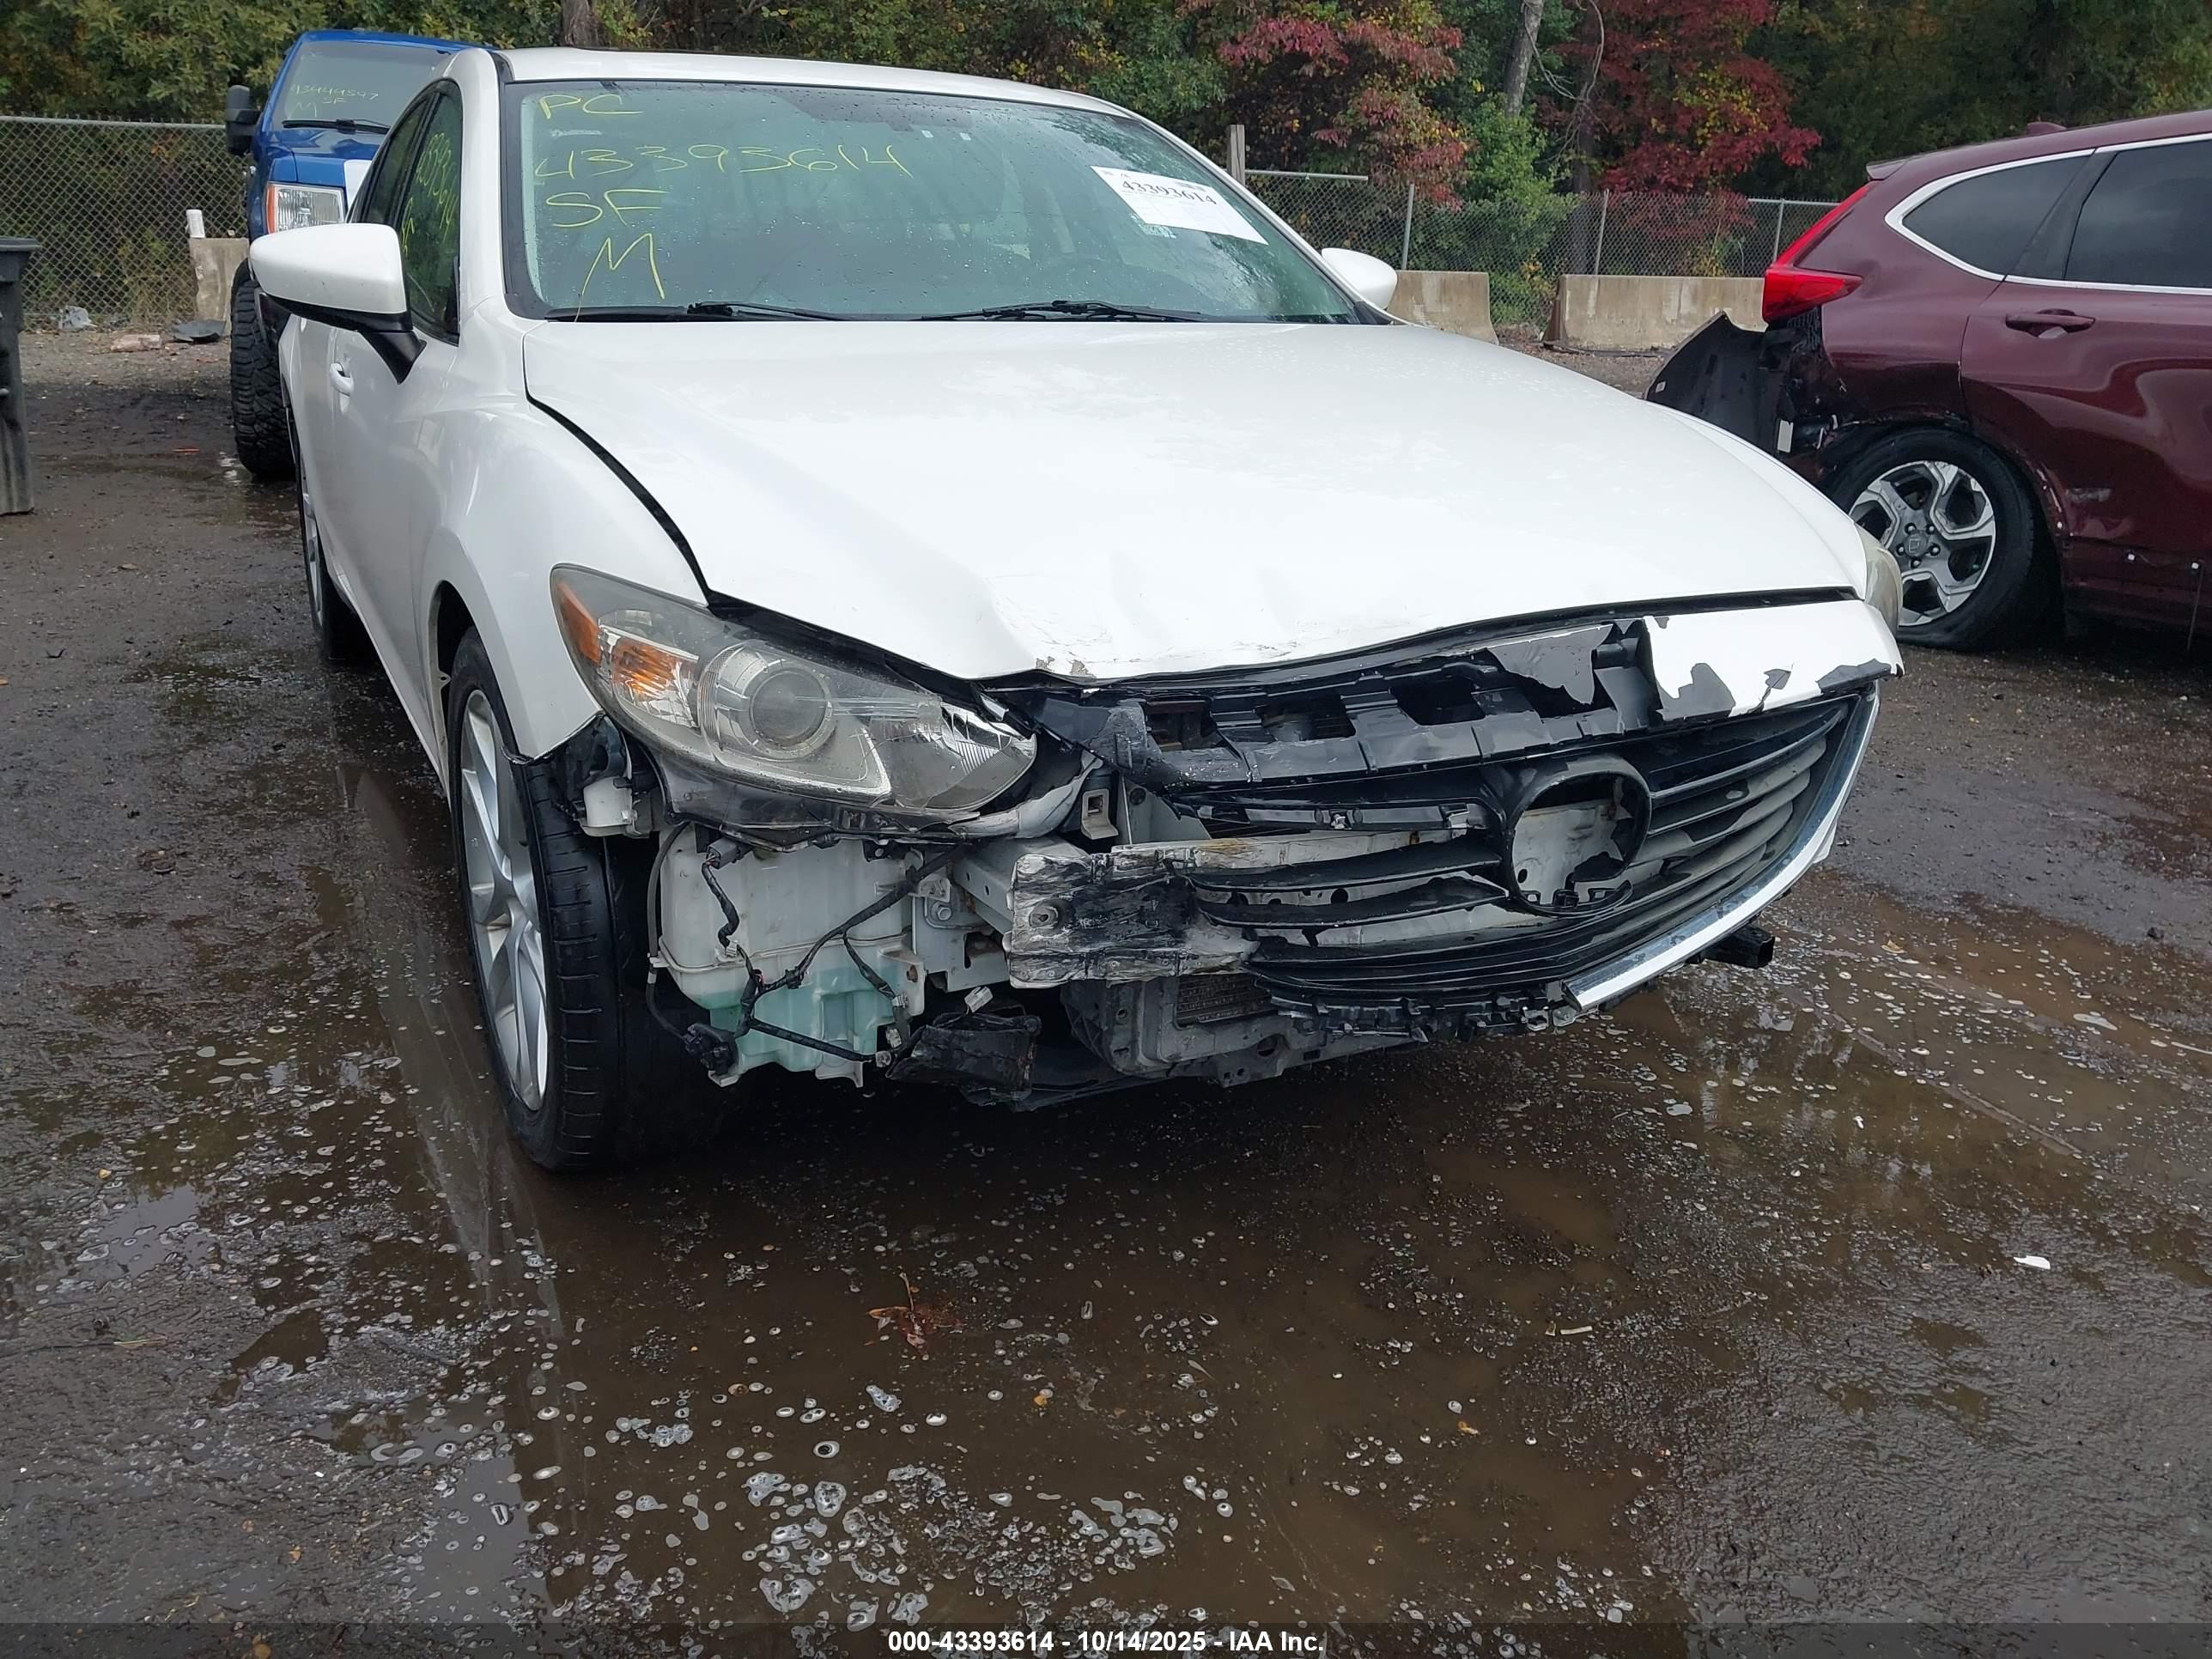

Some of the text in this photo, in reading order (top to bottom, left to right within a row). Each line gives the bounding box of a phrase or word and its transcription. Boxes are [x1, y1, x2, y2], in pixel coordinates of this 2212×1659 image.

[539, 94, 644, 119] PC
[534, 144, 914, 179] 43393614
[546, 189, 669, 228] SF
[1122, 179, 1218, 205] 43393614
[575, 232, 665, 301] M
